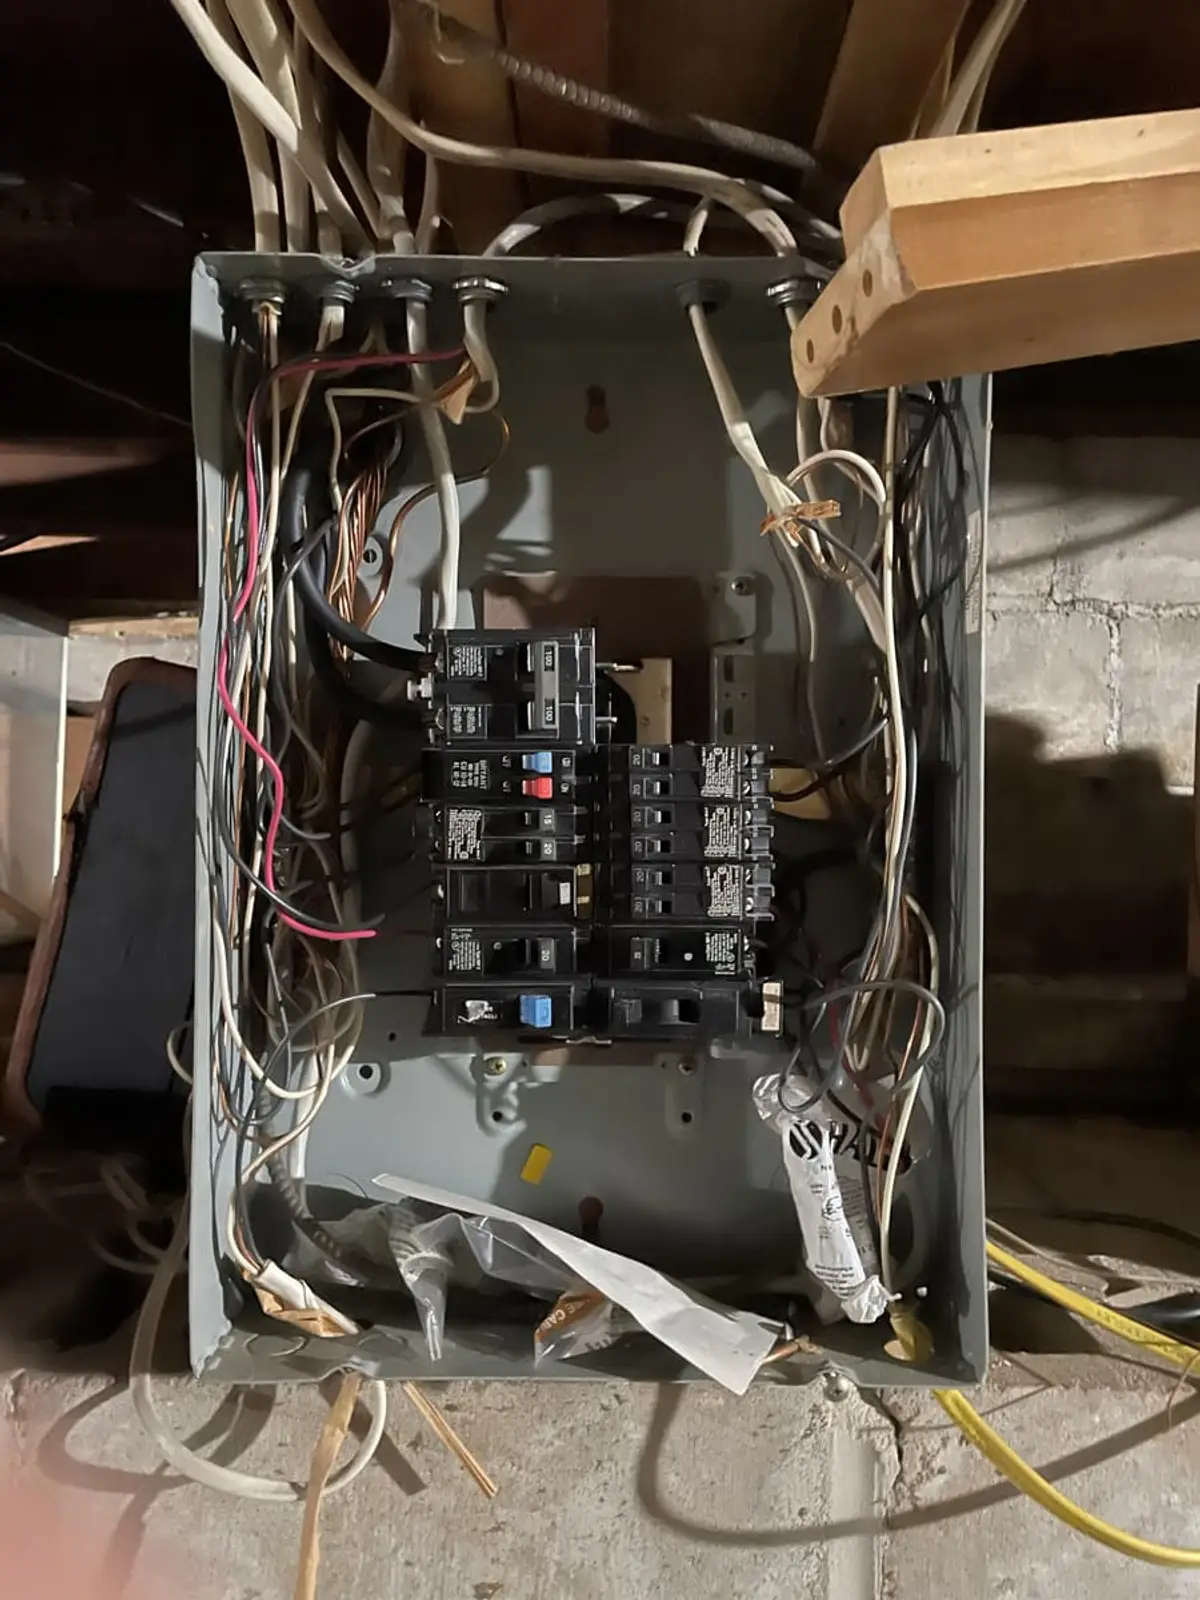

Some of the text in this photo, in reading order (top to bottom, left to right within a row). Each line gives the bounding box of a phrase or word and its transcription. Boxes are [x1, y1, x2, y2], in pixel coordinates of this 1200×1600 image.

[544, 650, 553, 666] 100
[545, 706, 553, 722] 100
[632, 753, 641, 766] 20
[479, 759, 487, 790] BRYANT
[632, 783, 641, 796] 20
[543, 843, 553, 855] 20
[634, 841, 643, 853] 20
[541, 949, 550, 962] 20
